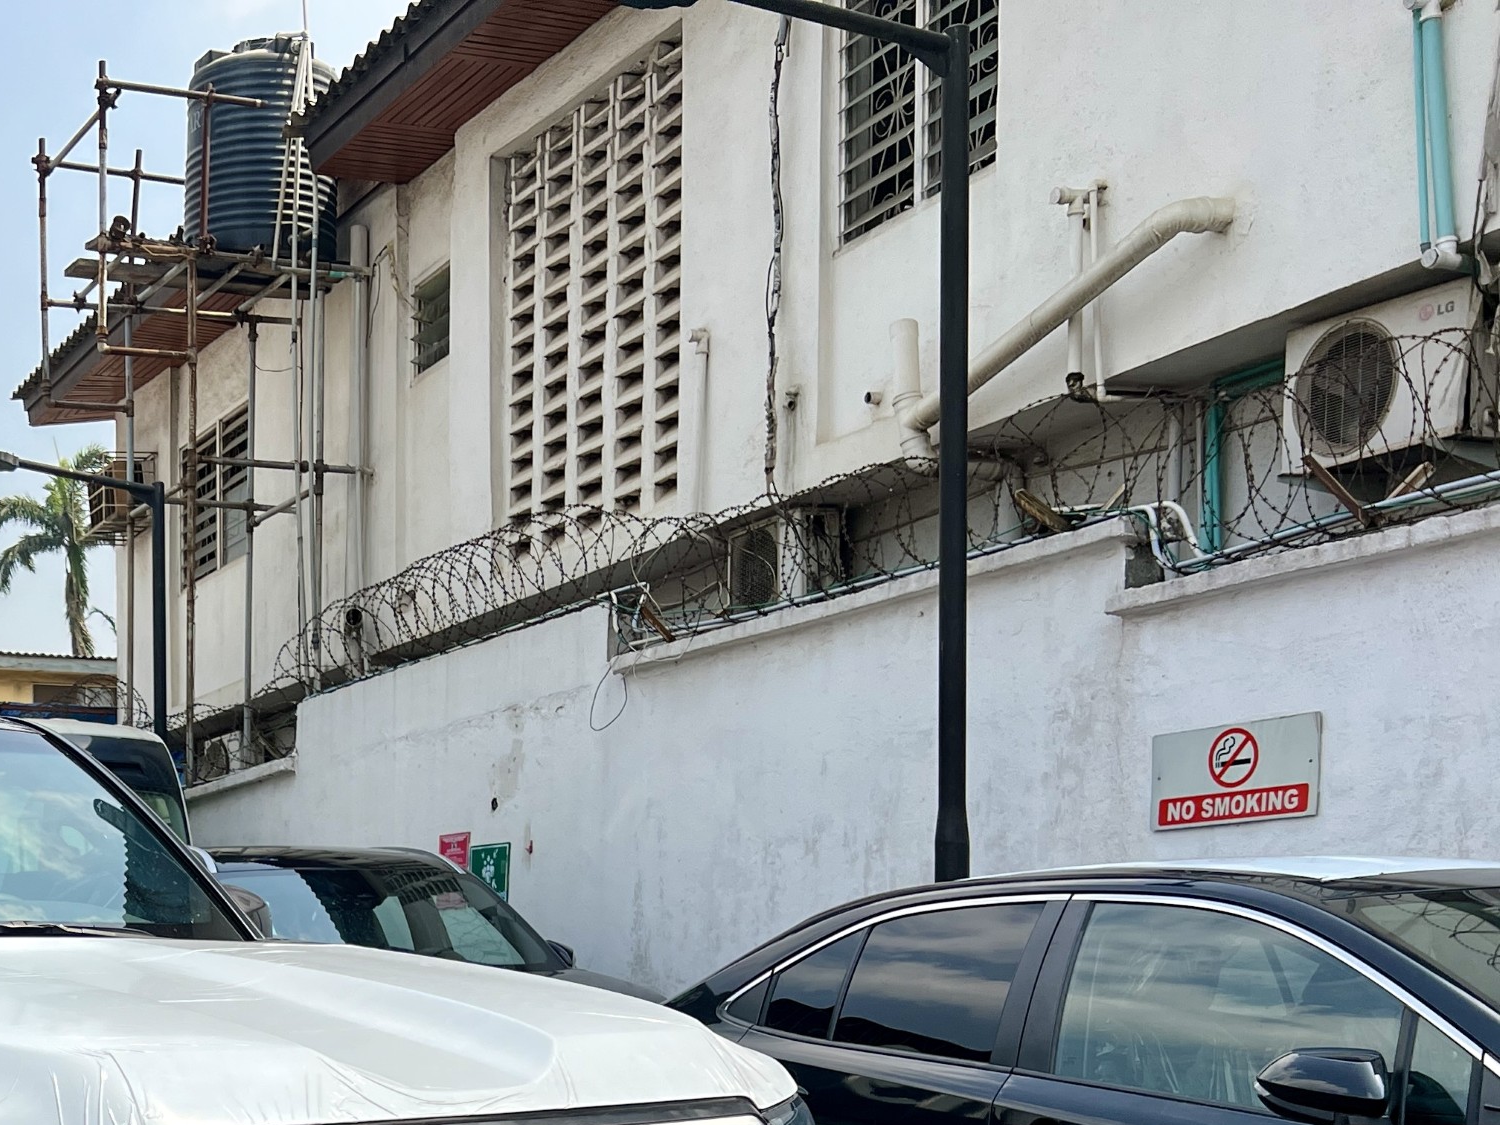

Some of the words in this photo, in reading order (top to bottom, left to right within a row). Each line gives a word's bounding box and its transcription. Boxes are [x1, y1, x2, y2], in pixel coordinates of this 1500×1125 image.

[1436, 300, 1455, 316] LG
[1166, 800, 1196, 822] NO
[1201, 788, 1299, 818] SMOKING
